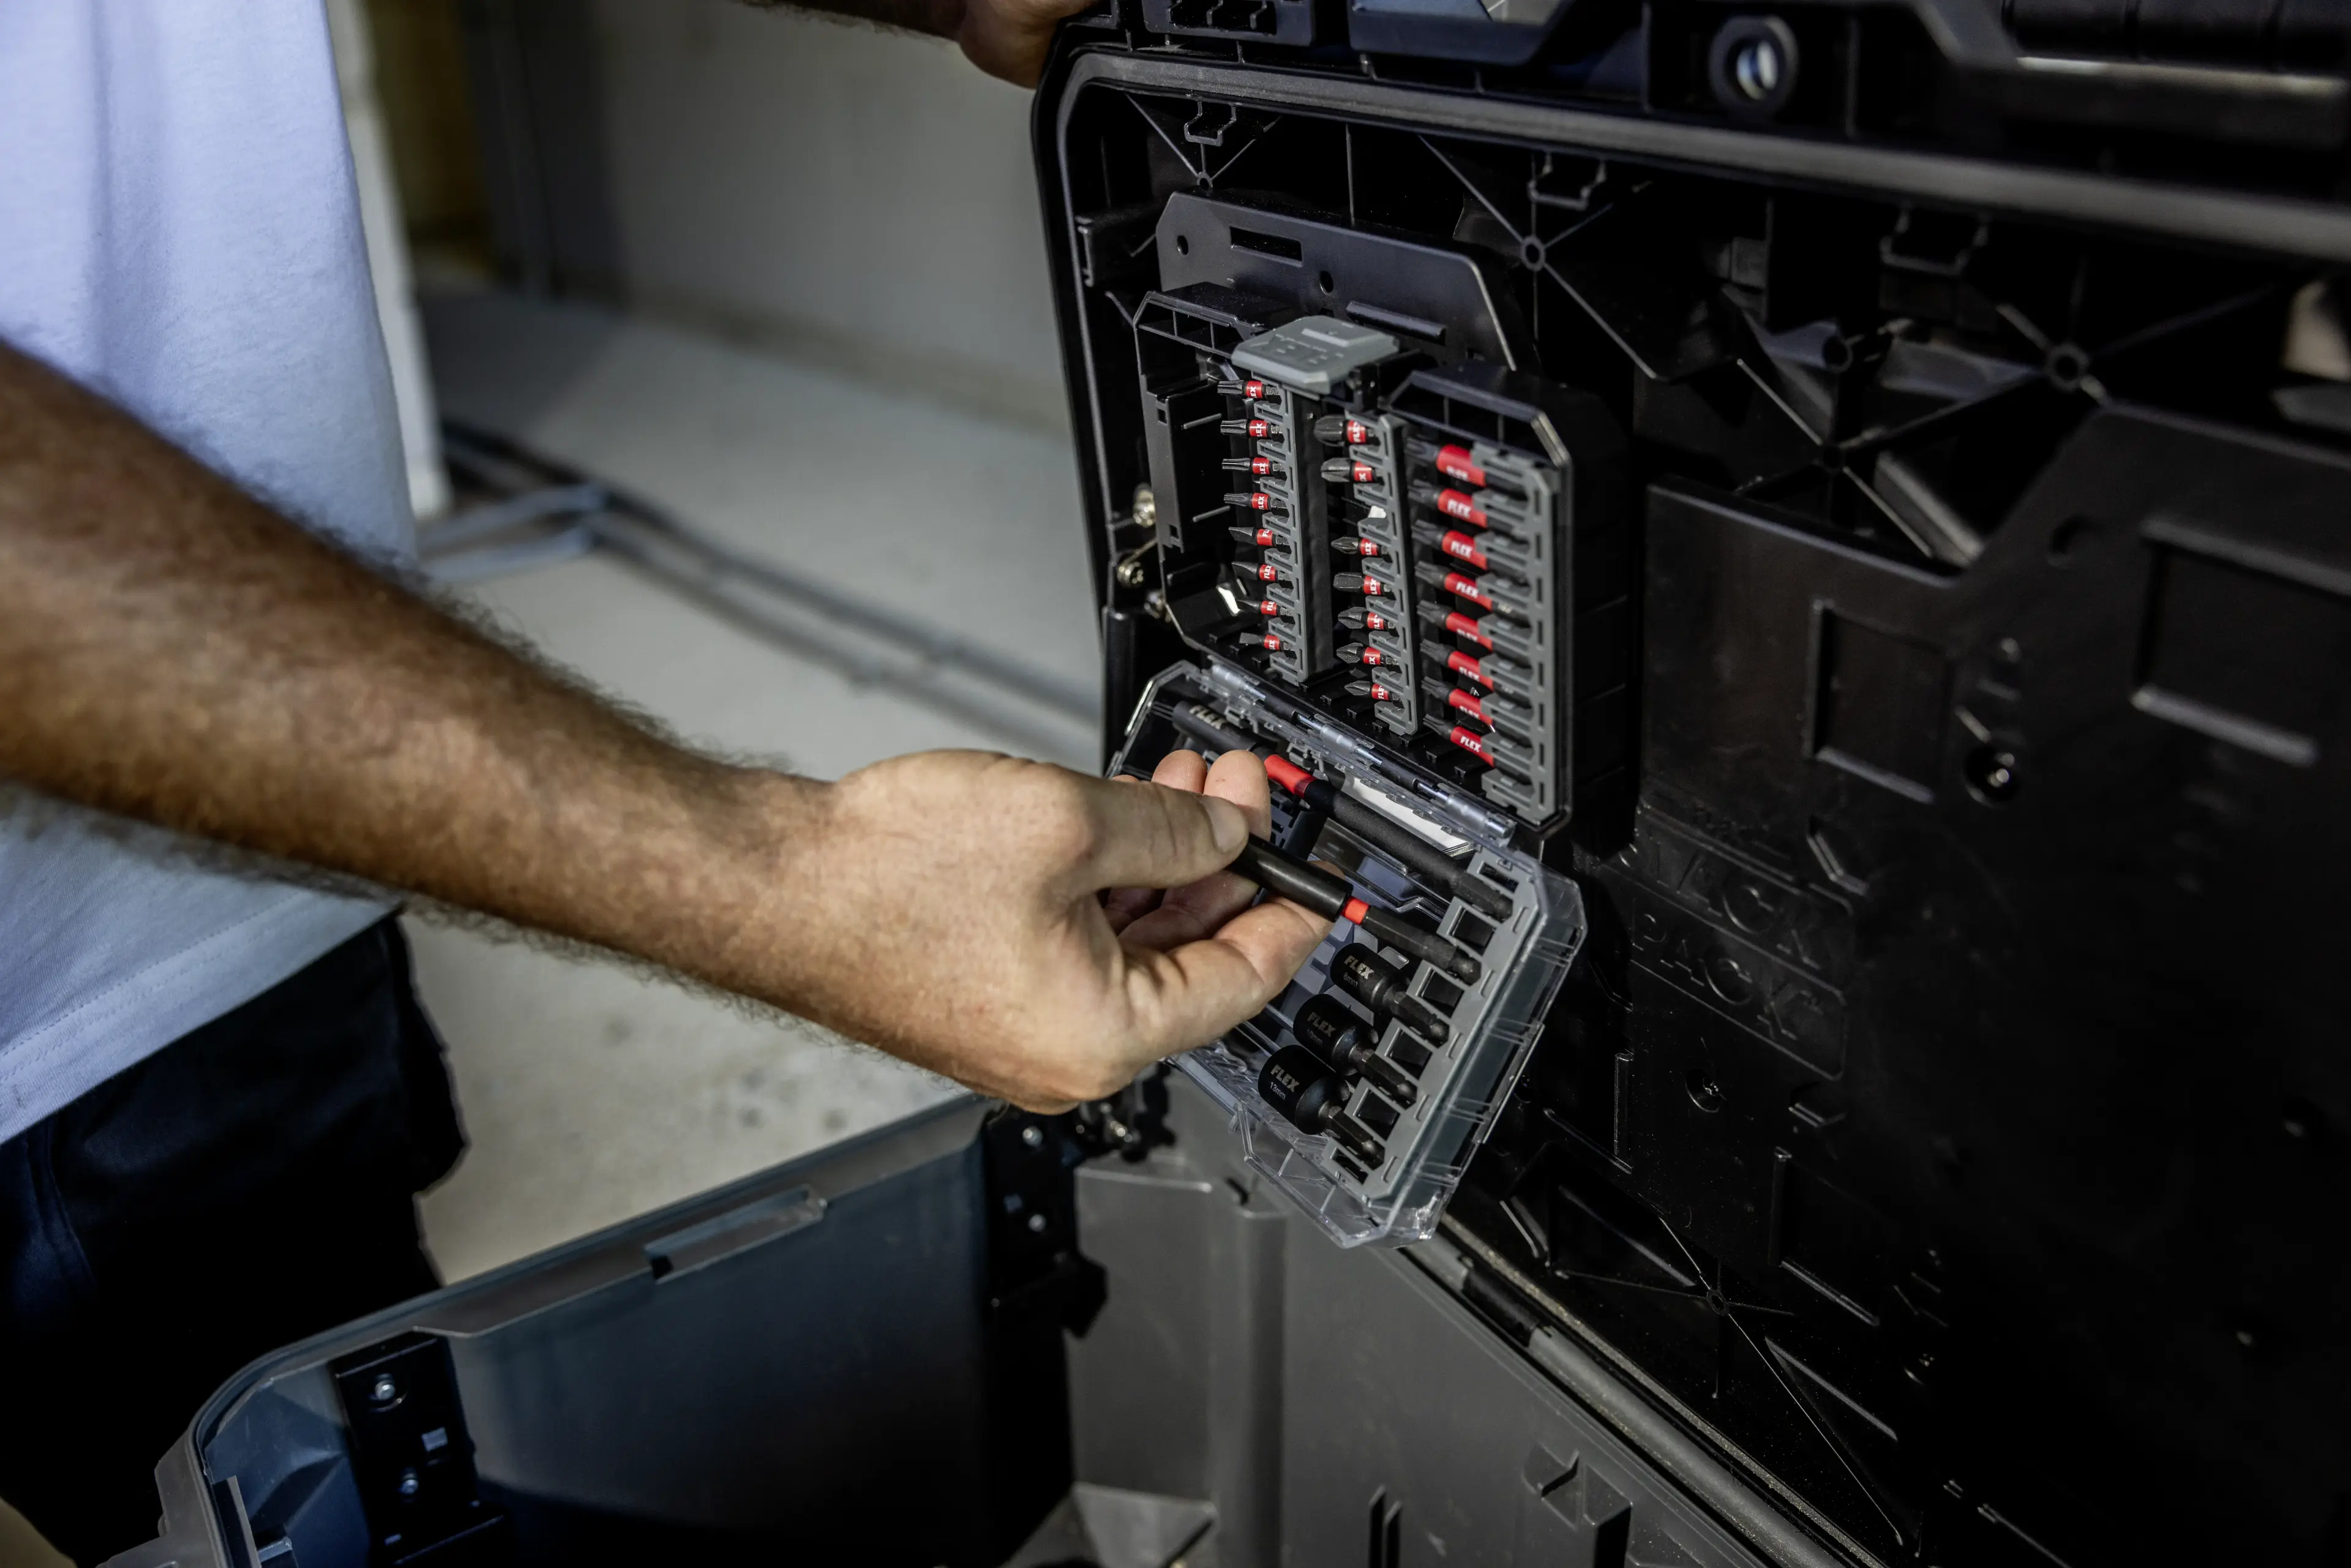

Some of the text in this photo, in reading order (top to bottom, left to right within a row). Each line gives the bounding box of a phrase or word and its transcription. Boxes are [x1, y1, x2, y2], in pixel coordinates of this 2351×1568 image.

[1447, 498, 1471, 519] FLEX
[1450, 540, 1473, 559] FLEX
[1455, 582, 1478, 599] FLEX
[1460, 735, 1481, 753] FLEX
[1343, 955, 1375, 980] FLEX
[1631, 896, 1813, 1041] PACK
[1343, 972, 1359, 988] 8mm
[1307, 1011, 1337, 1038] FLEX
[1270, 1064, 1300, 1093] FLEX
[1269, 1081, 1286, 1101] 13mm
